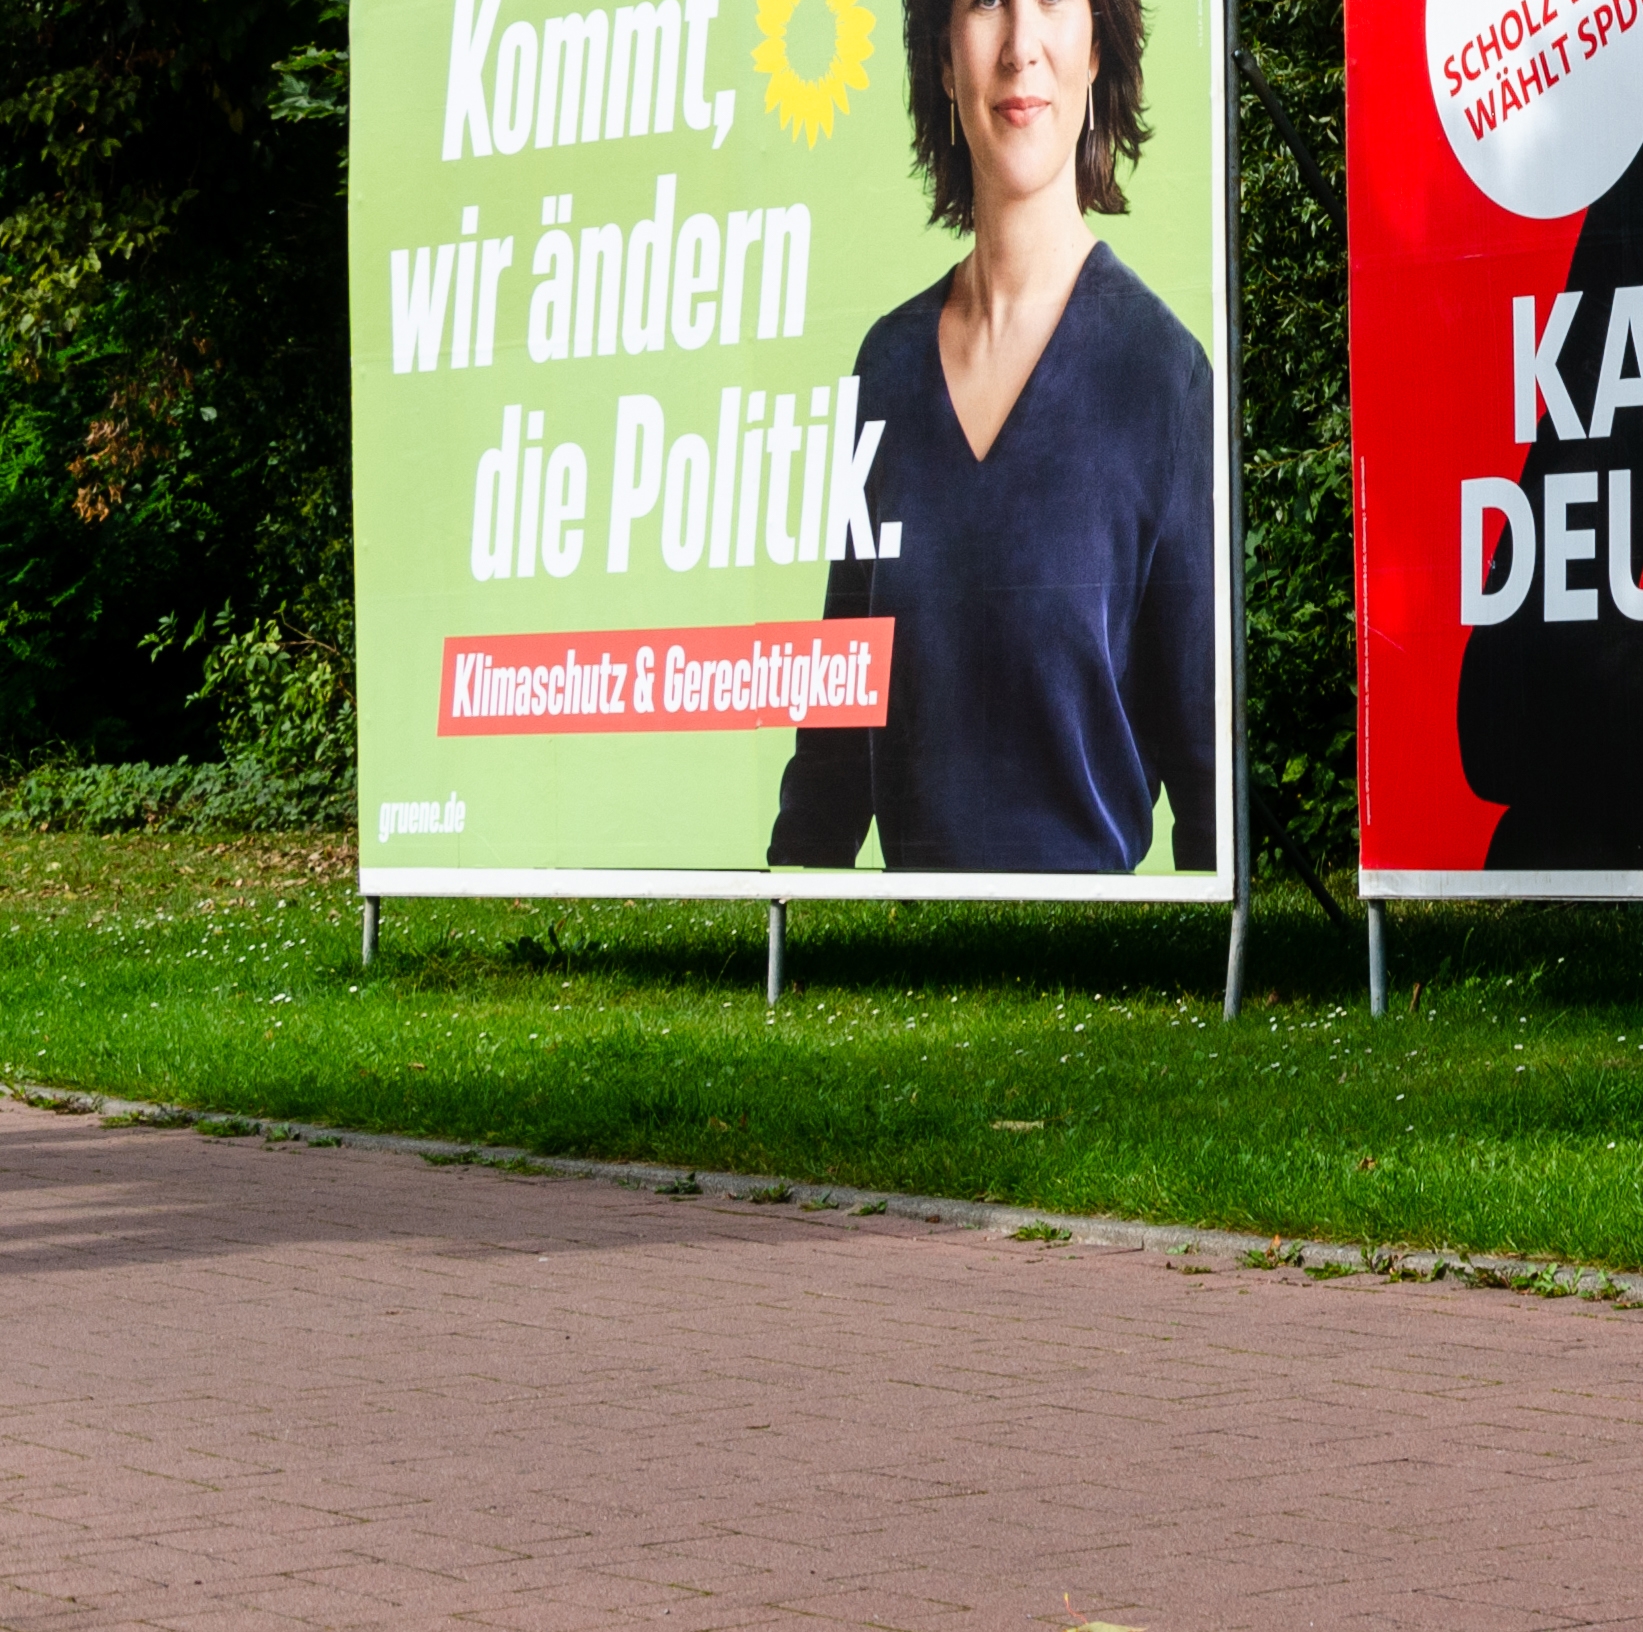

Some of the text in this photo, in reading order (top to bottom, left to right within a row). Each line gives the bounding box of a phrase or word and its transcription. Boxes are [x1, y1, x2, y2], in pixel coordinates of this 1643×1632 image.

[1464, 33, 1570, 141] WÄHLT
[390, 173, 812, 375] wir ändern
[470, 375, 902, 582] die Politik.
[451, 638, 878, 722] Klimaschutz & Gerechtigkeit.
[378, 790, 466, 843] gruene.de
